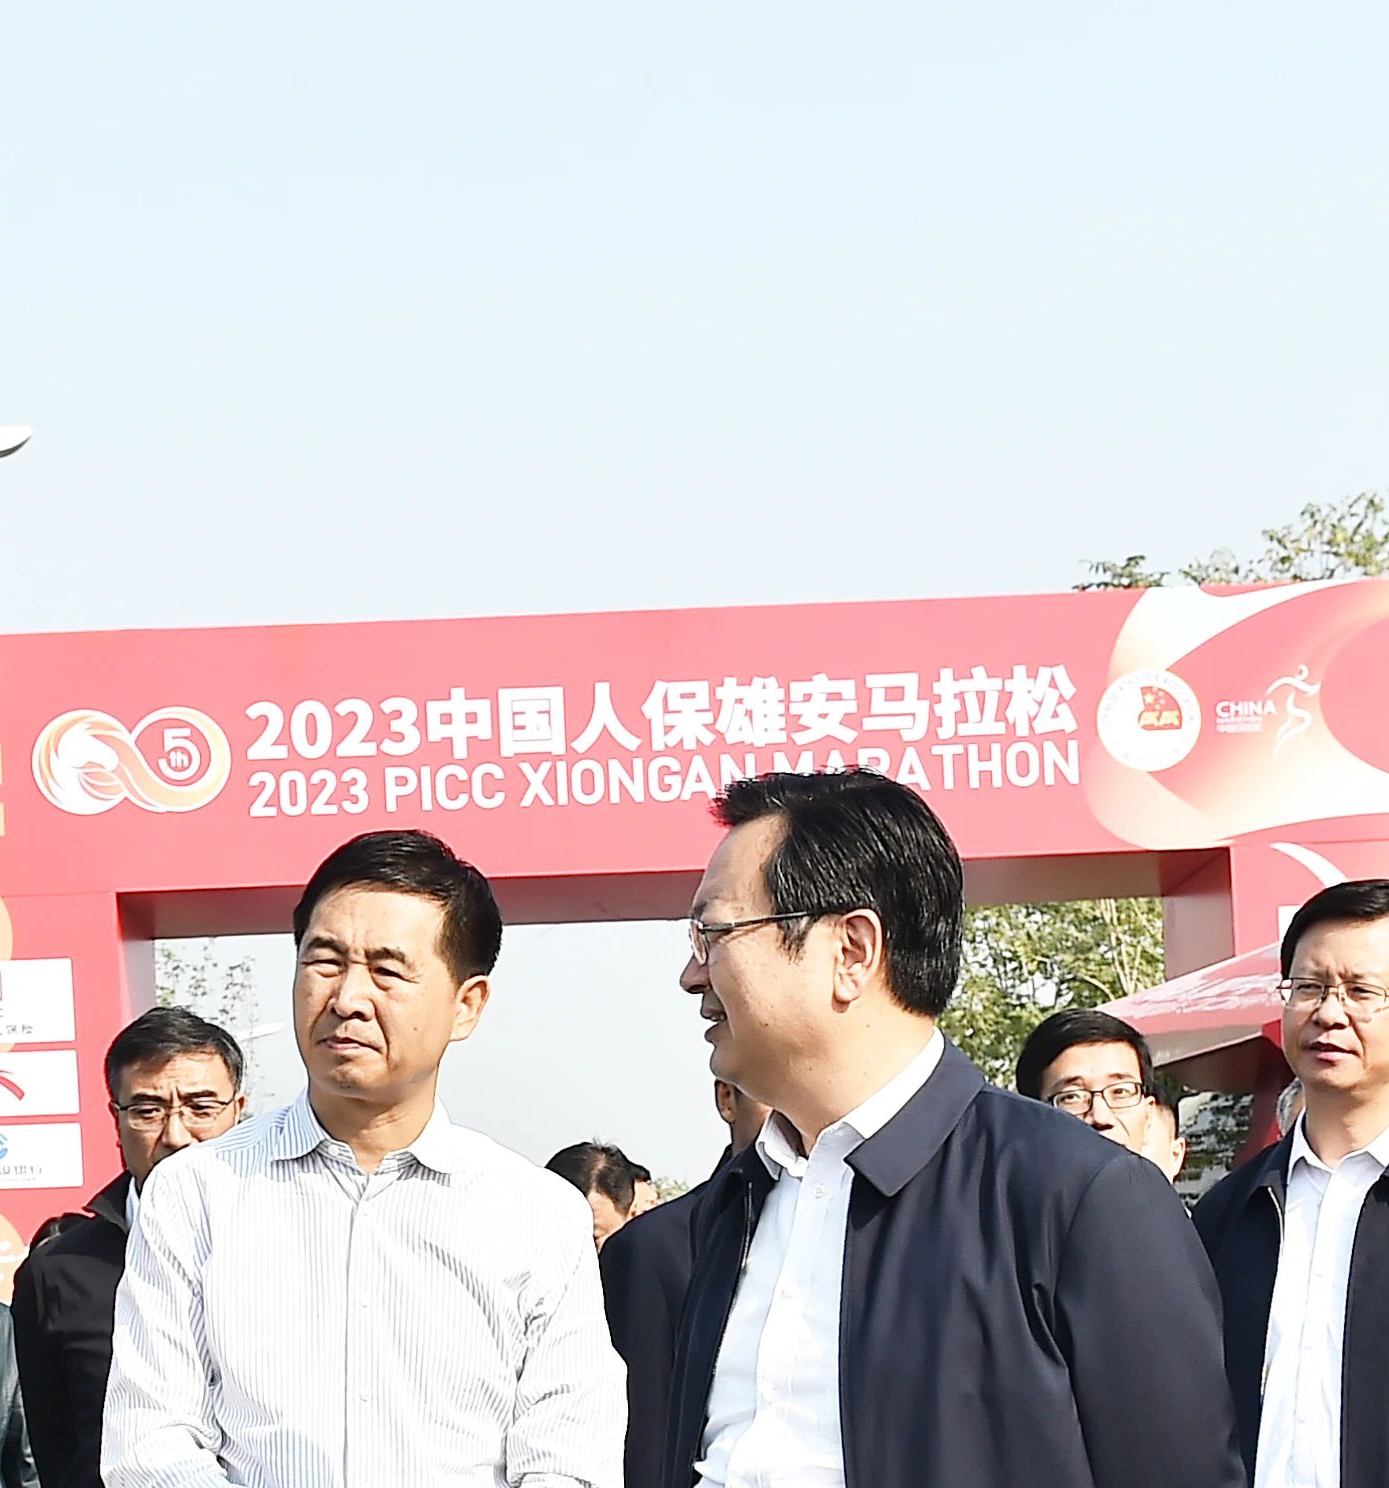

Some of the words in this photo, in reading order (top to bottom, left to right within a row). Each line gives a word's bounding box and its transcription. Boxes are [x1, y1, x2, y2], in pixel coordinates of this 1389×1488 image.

[244, 664, 1079, 761] 2023中国人保雄安马拉松
[1215, 700, 1276, 718] CHINA
[247, 767, 370, 818] 2023
[384, 762, 506, 813] PICC
